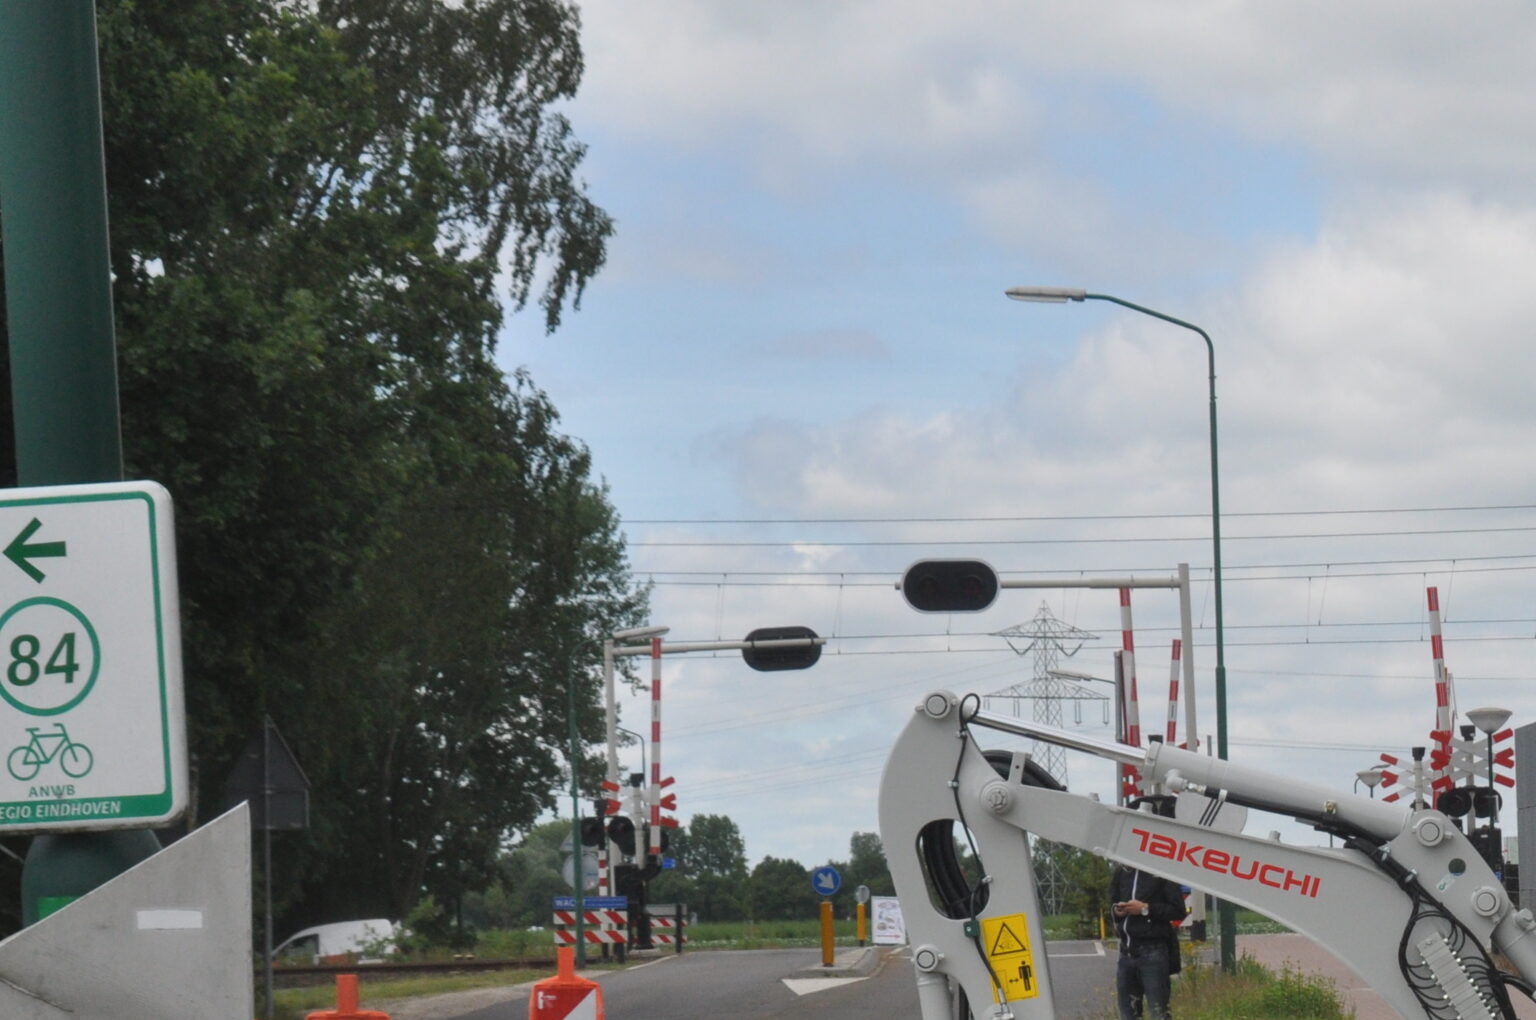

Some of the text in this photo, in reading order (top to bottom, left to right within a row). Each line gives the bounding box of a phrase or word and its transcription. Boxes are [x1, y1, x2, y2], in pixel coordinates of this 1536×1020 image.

[7, 632, 80, 687] 84
[28, 784, 76, 797] ANWB
[0, 801, 121, 819] EGIO EINDHOVEN
[1132, 827, 1320, 898] TAKEUCHI
